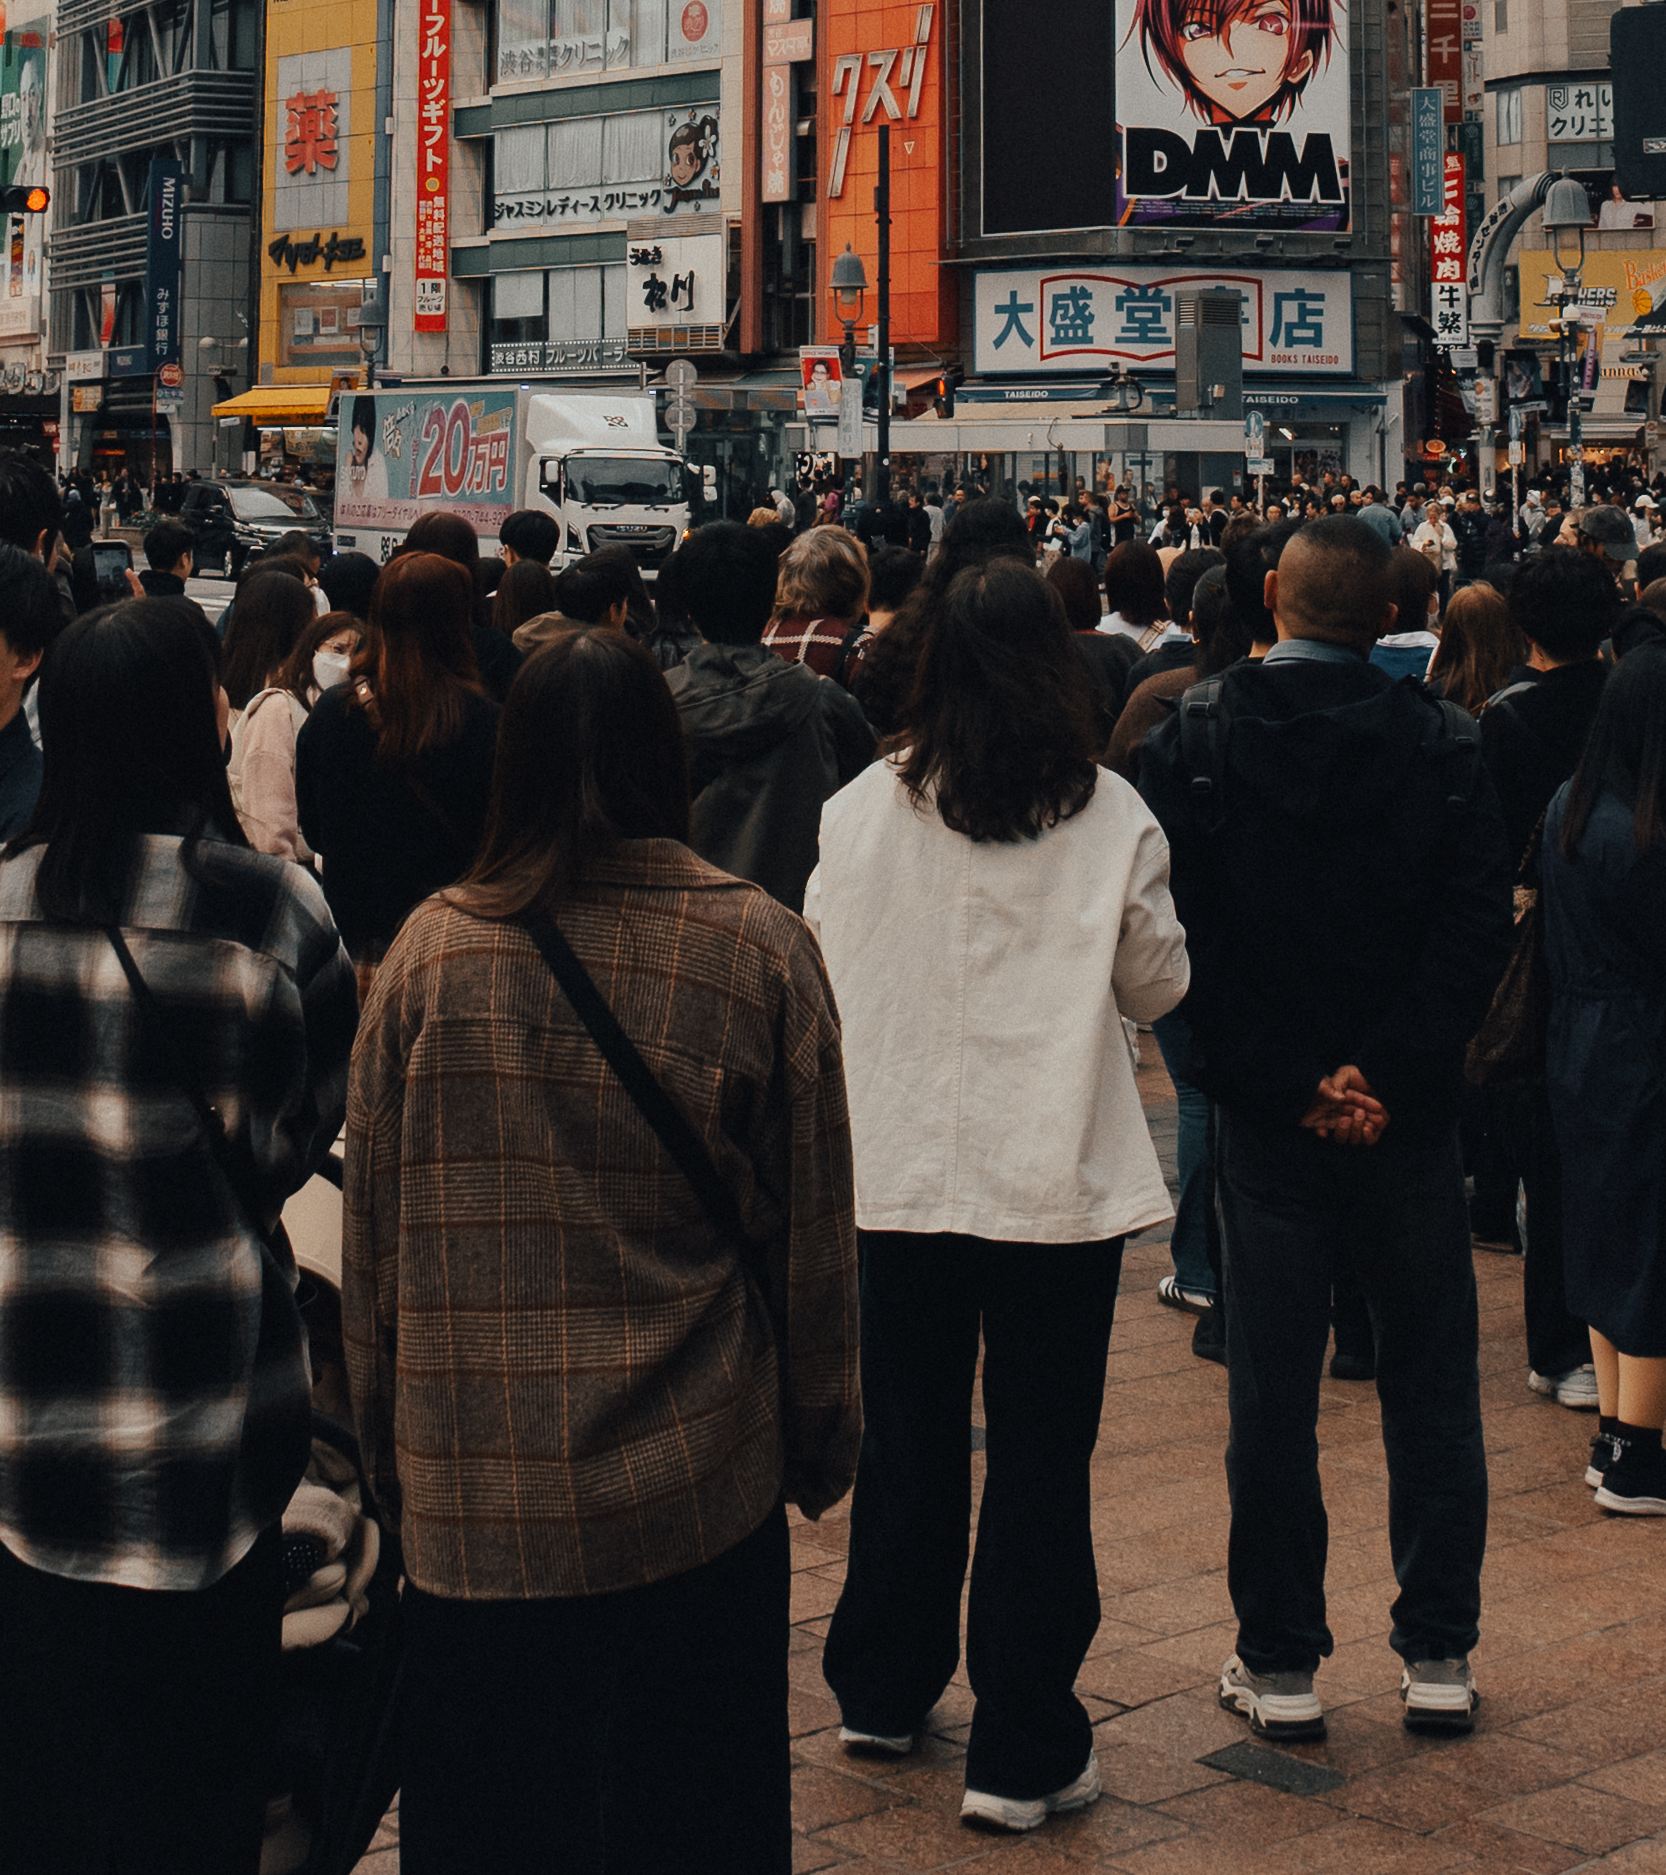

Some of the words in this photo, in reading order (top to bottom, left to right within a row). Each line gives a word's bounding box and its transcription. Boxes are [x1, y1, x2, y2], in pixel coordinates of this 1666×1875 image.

[283, 88, 340, 176] 薬
[1417, 95, 1437, 209] 大盛堂商事ビル
[1551, 115, 1613, 137] クリニ
[1123, 127, 1344, 203] DMM
[159, 176, 175, 241] MIZUHO
[494, 189, 661, 220] ジャスミンレディースクリニック
[155, 288, 170, 356] みずほ銀行
[993, 284, 1325, 349] 大盛堂店
[1437, 284, 1462, 334] 牛繁
[1271, 353, 1297, 364] BOOKS
[1302, 353, 1339, 365] TAISEIDO
[1004, 390, 1049, 399] TAISEIDO
[418, 398, 511, 500] 20万円
